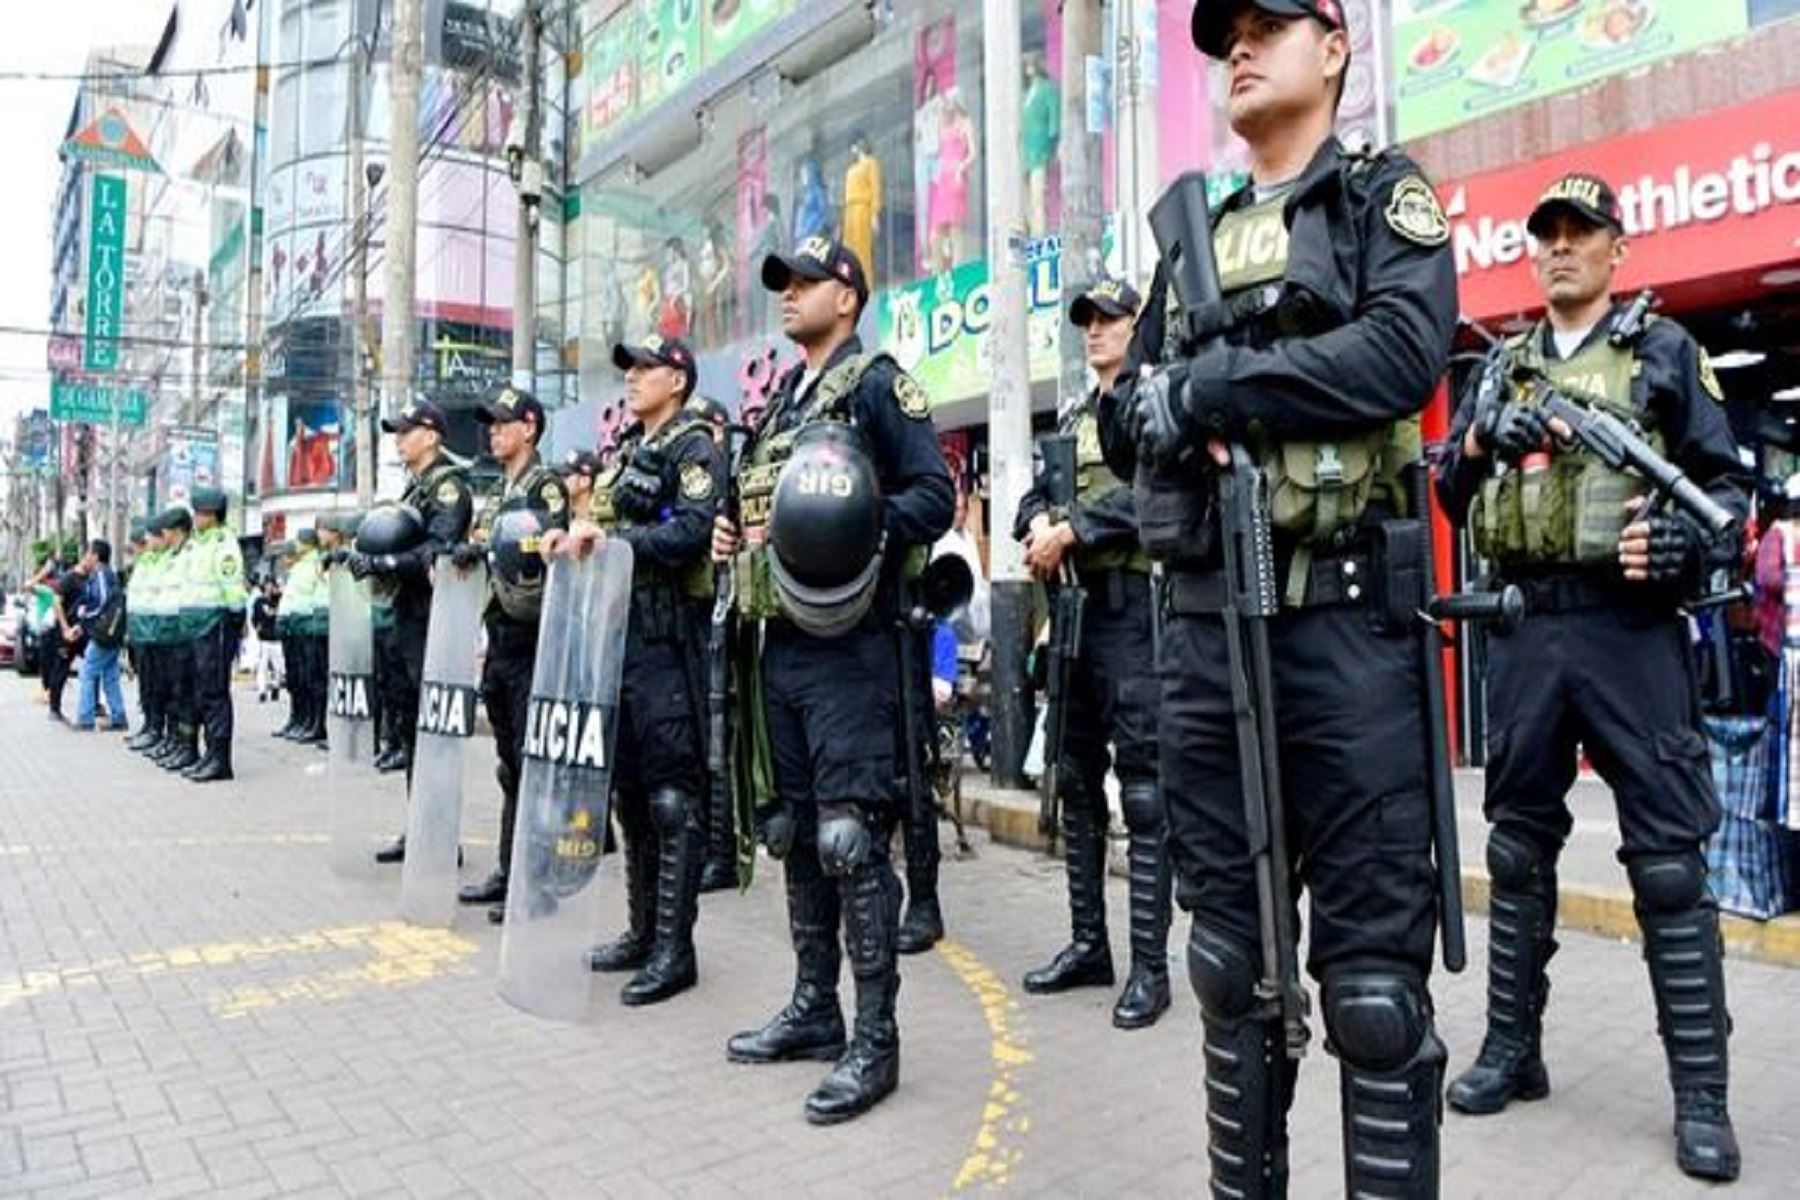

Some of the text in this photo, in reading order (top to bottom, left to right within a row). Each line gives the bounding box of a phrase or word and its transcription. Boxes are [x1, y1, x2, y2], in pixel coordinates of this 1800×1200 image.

[1620, 142, 1800, 237] thletic
[1216, 215, 1290, 273] LICI
[93, 183, 117, 366] LA TORRE
[329, 677, 369, 717] CIA
[417, 685, 467, 734] CIA
